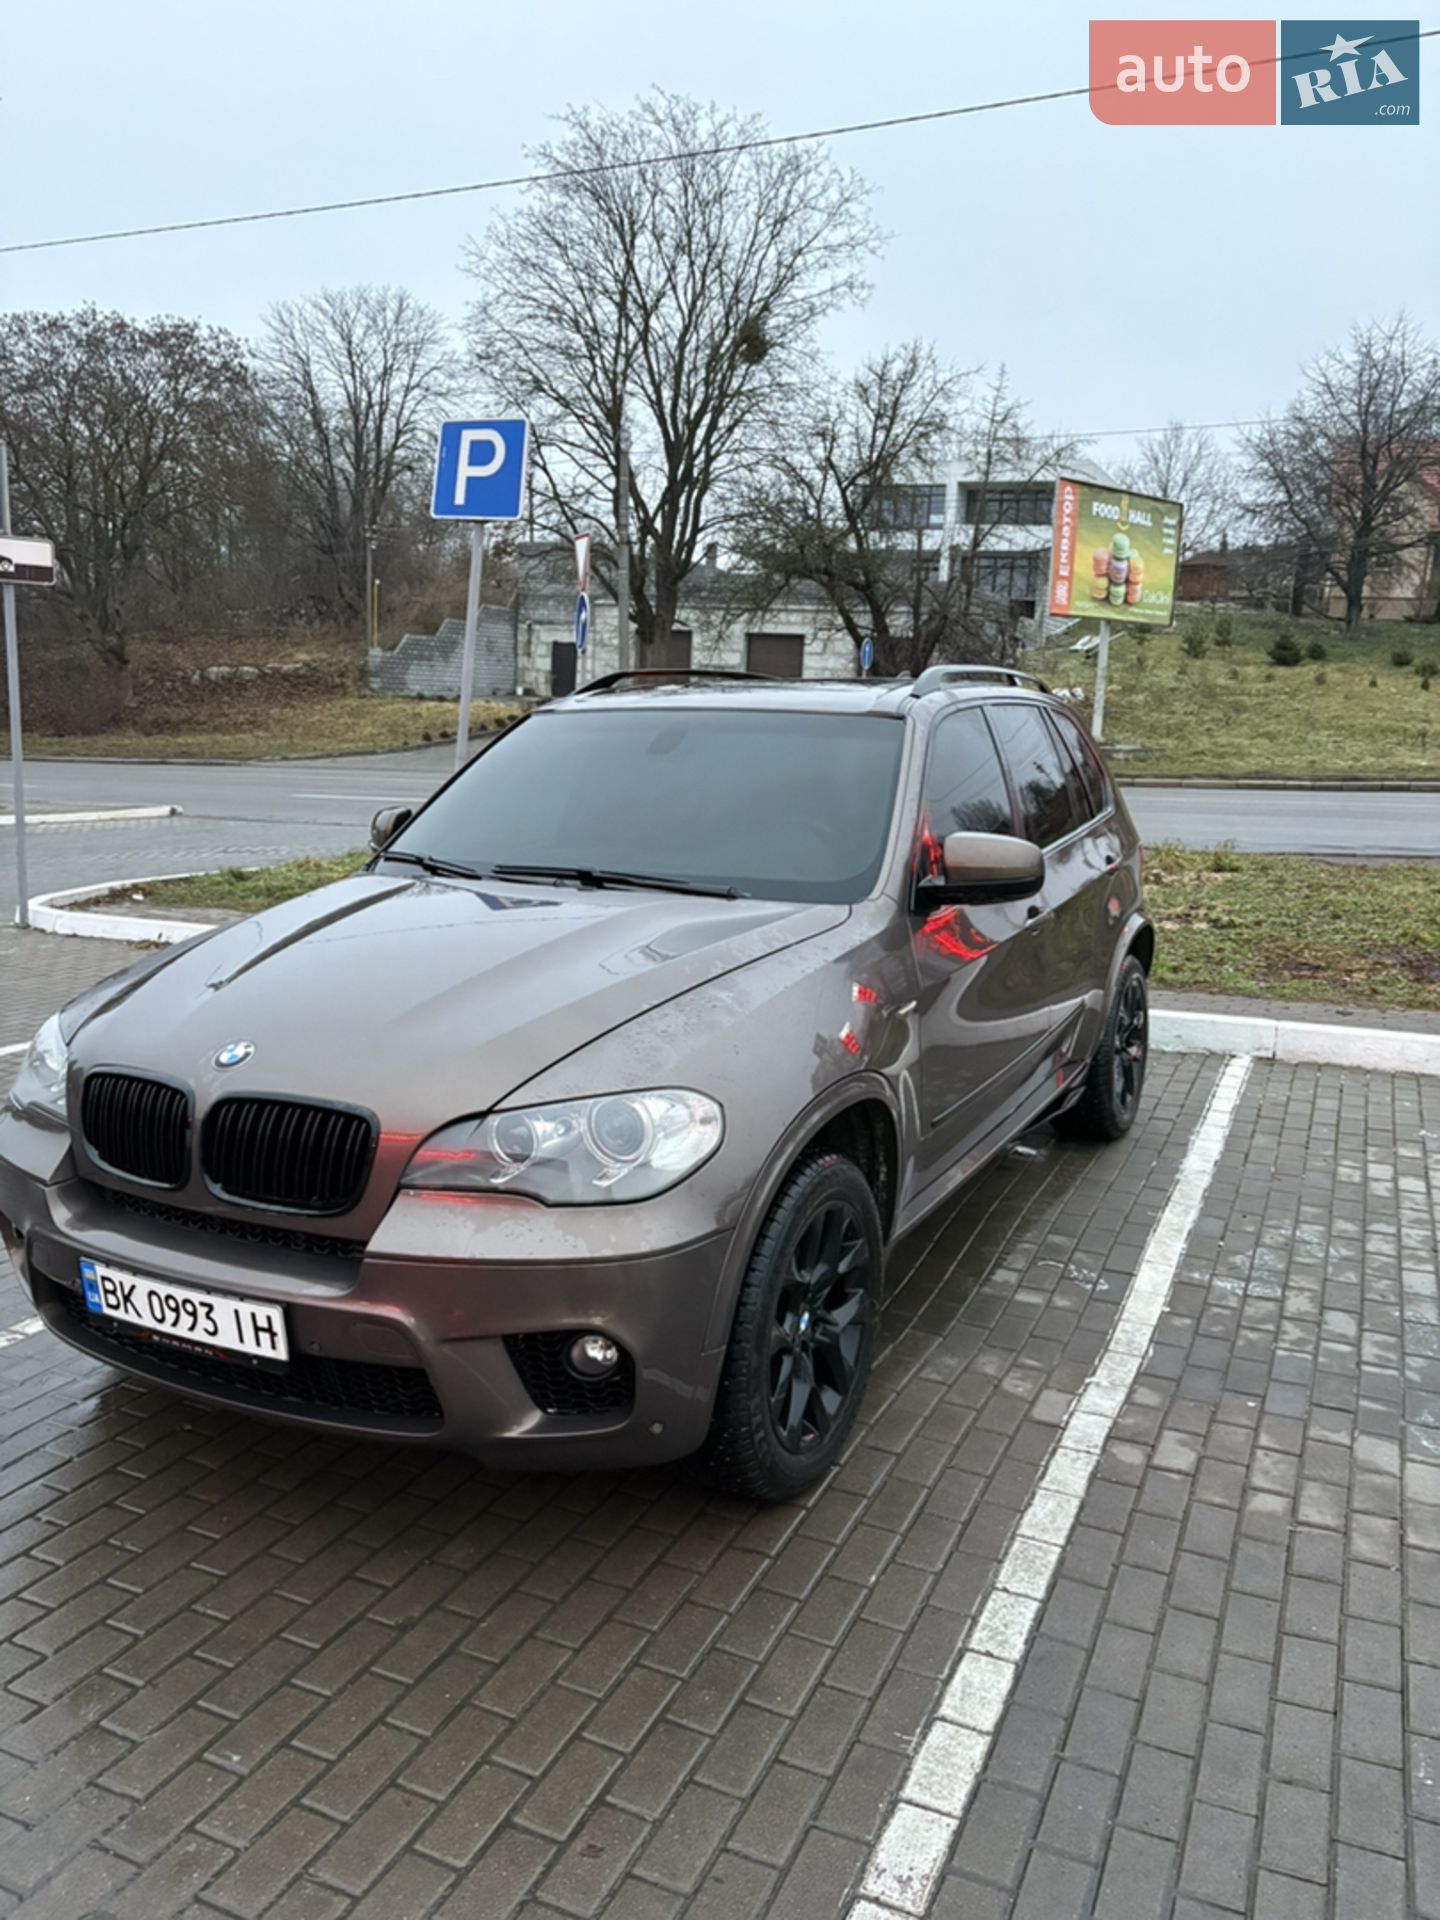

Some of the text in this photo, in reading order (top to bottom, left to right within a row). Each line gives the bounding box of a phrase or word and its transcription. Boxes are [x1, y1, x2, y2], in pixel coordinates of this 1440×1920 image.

[454, 428, 506, 505] P
[1092, 502, 1120, 520] FOOD
[1128, 509, 1153, 527] HALL
[100, 1275, 278, 1351] BK 0993 IH
